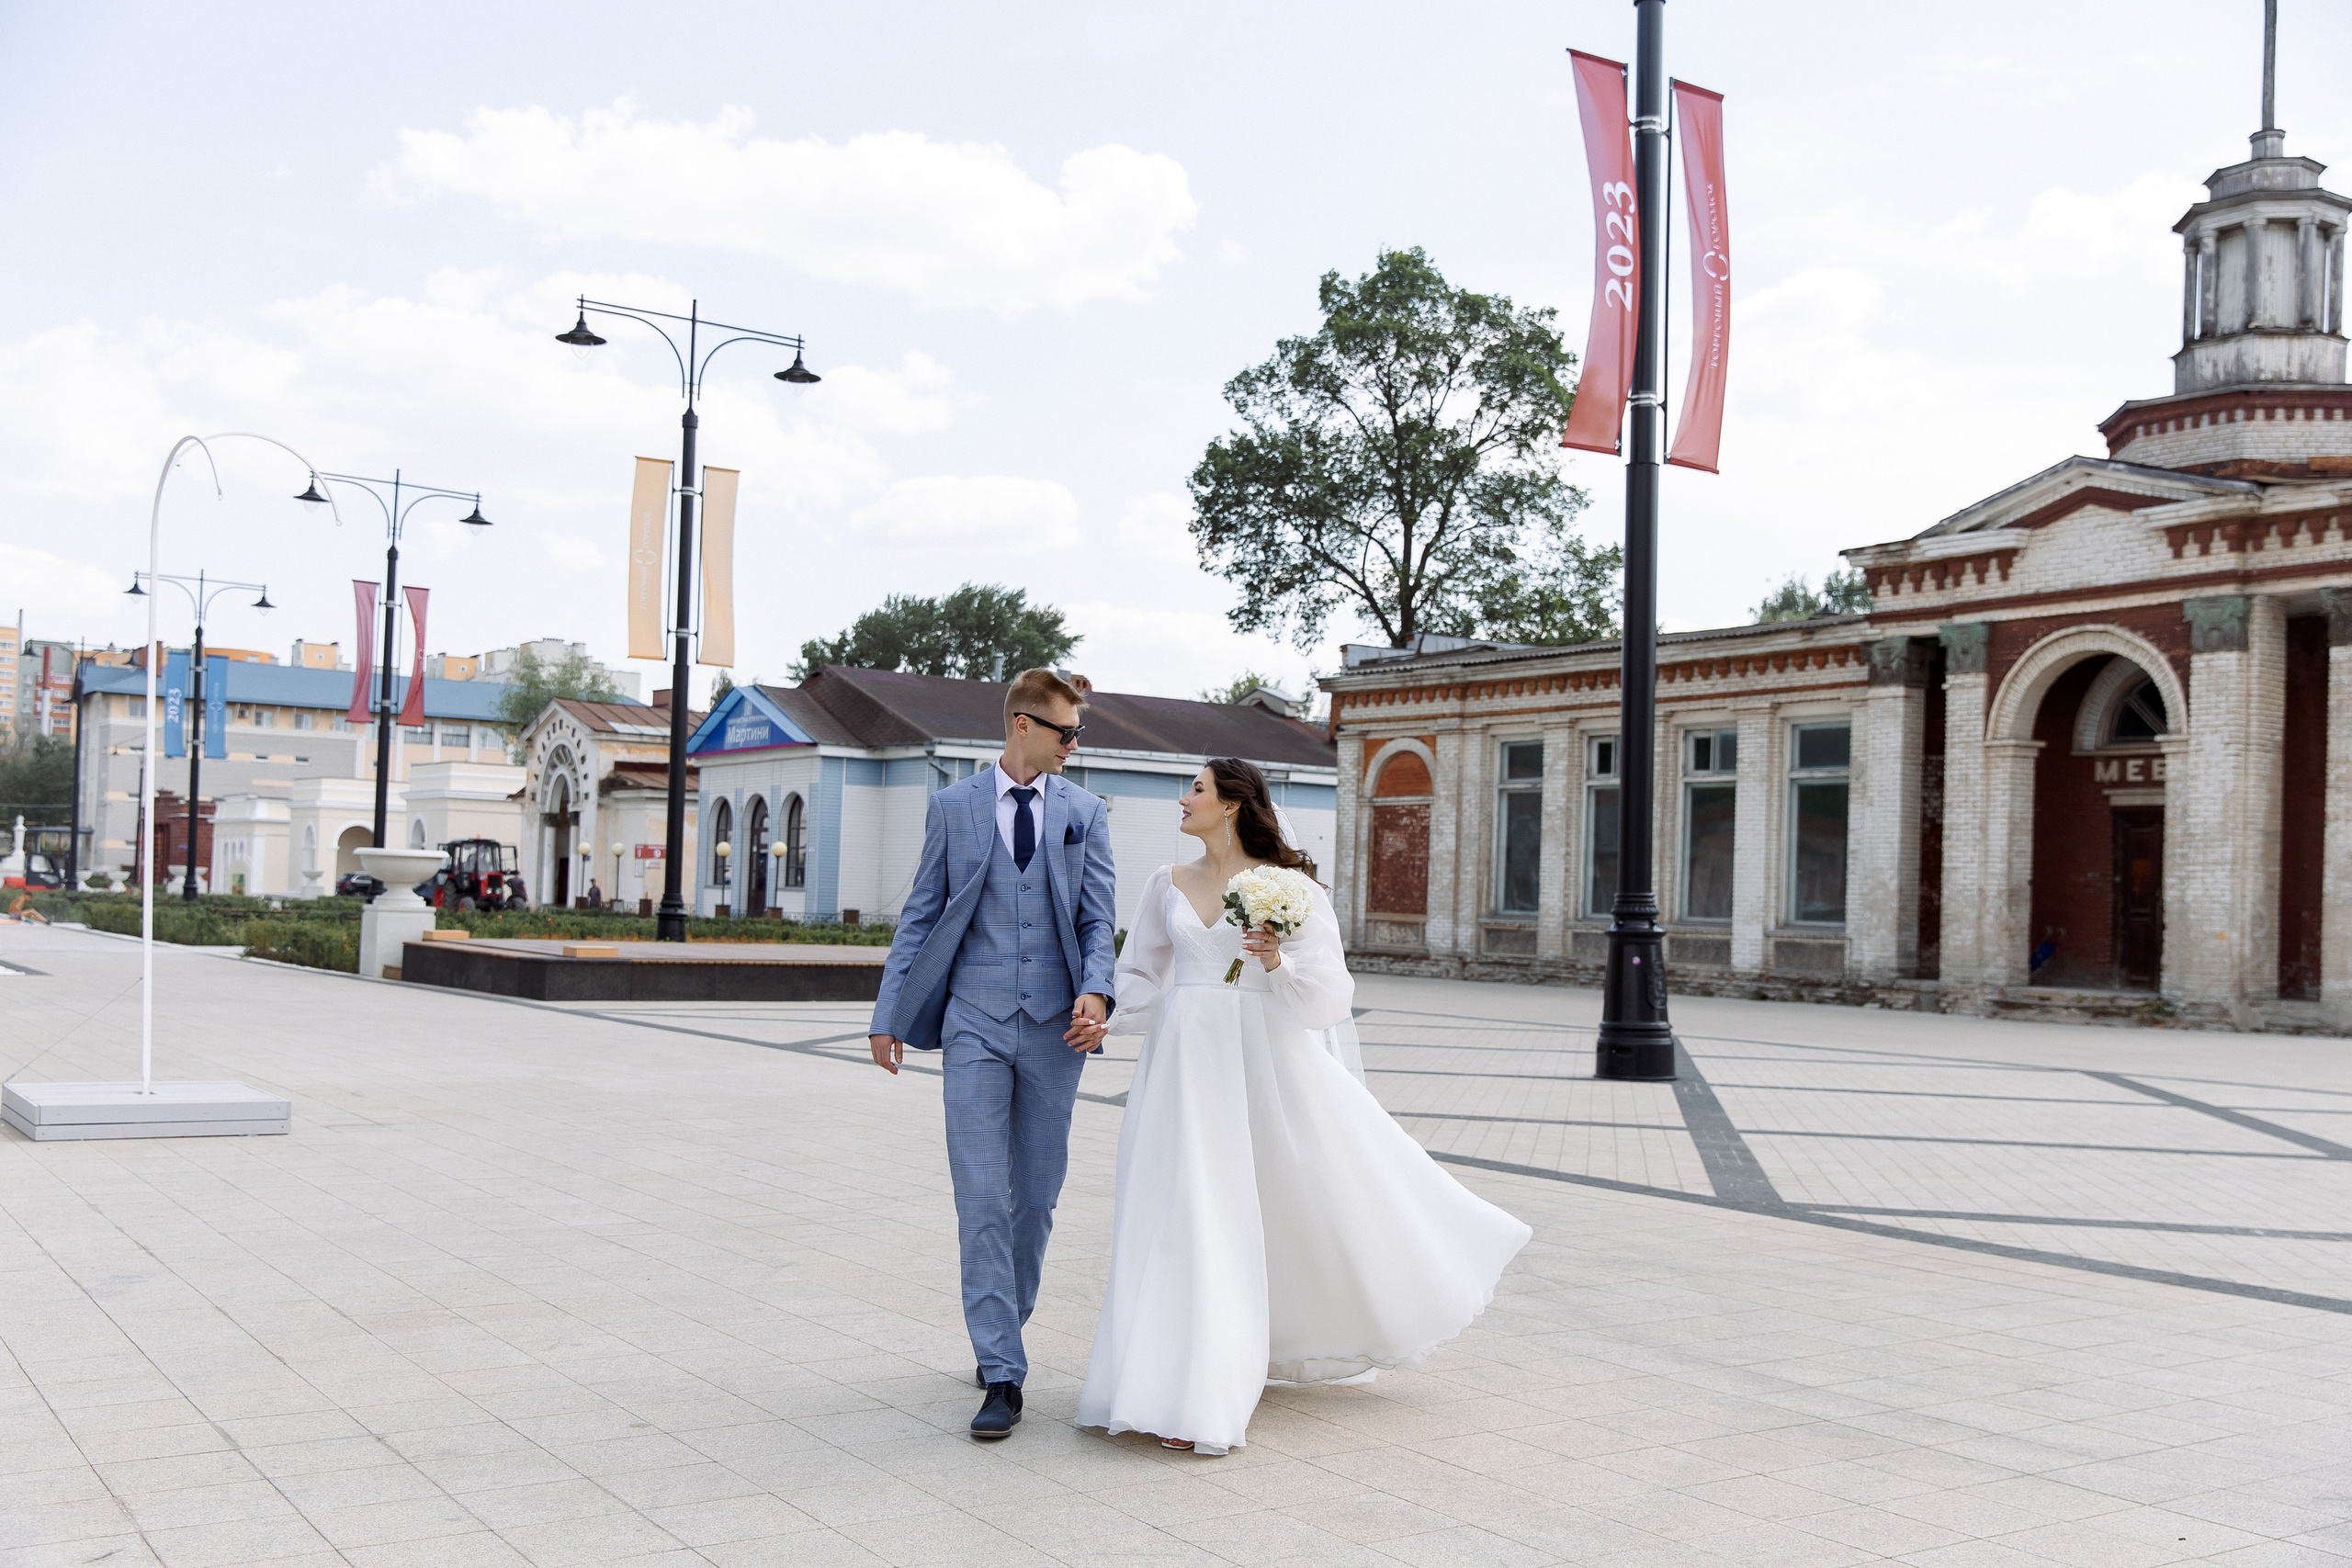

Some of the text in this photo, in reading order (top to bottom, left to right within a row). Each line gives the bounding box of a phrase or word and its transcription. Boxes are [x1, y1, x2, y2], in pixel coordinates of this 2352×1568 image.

[1603, 181, 1635, 311] 2023
[1711, 283, 1723, 367] ТОРГОВЫЙ
[168, 688, 182, 724] 2023
[727, 726, 769, 747] Мартини
